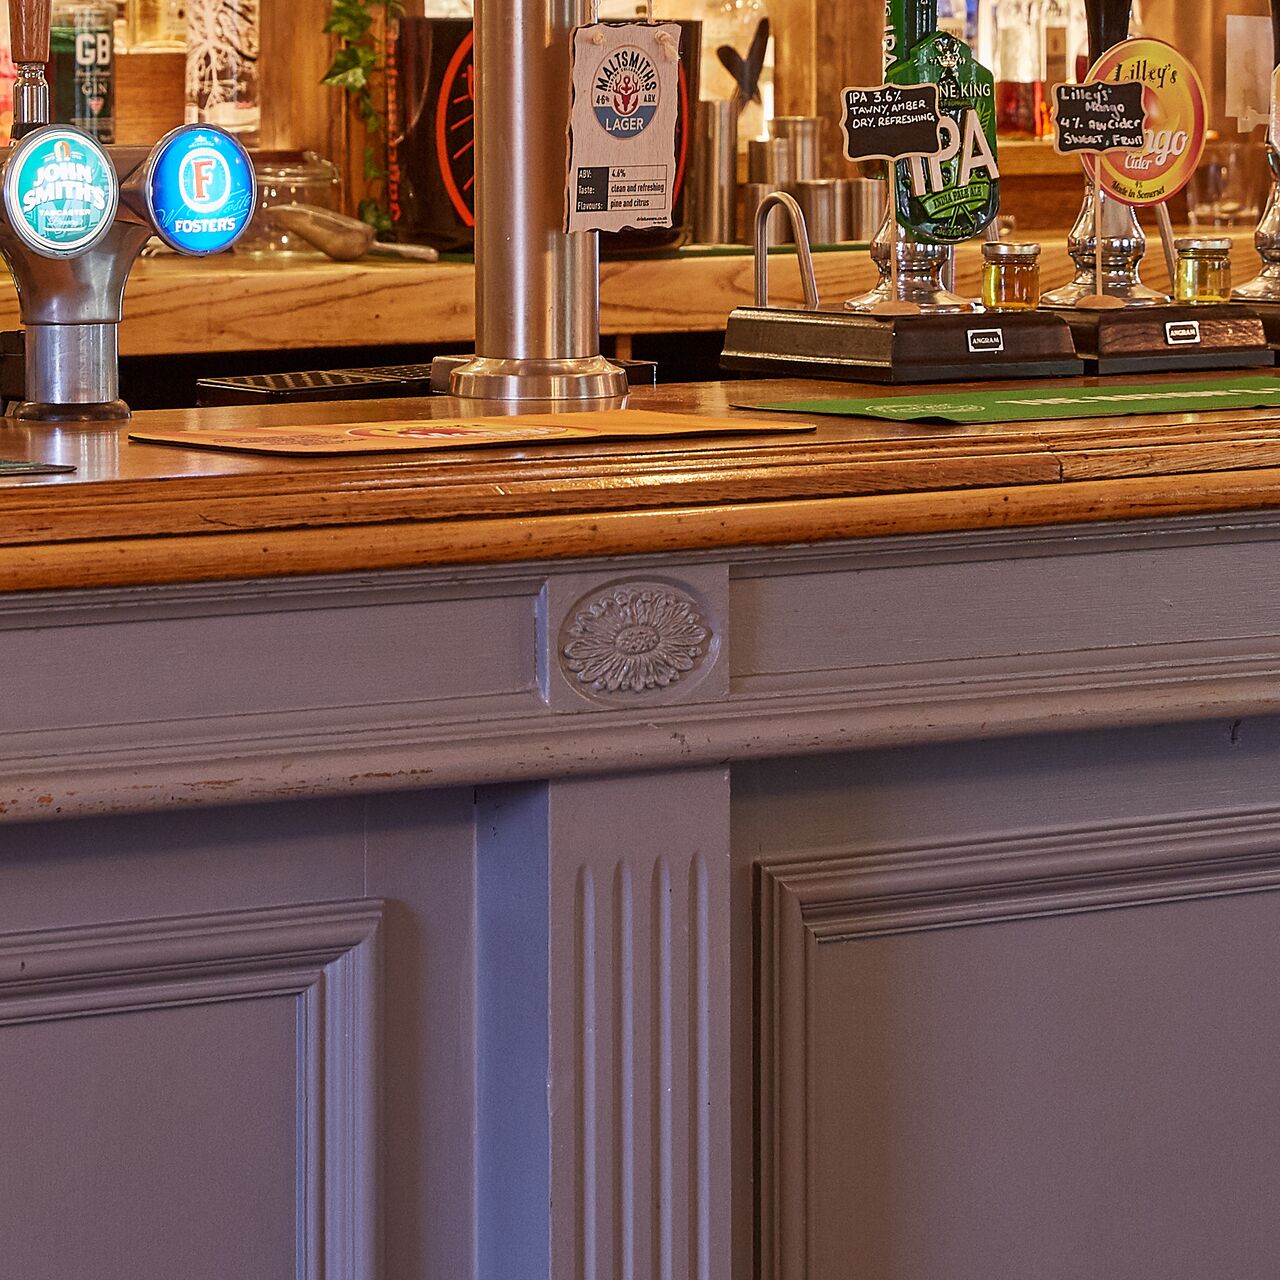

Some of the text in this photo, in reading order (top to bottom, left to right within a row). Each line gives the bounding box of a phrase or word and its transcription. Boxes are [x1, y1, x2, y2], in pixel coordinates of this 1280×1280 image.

[75, 33, 111, 65] GB
[882, 24, 898, 69] IPA
[595, 51, 657, 92] MALTSMITHS
[1114, 59, 1177, 89] Lilley's
[81, 80, 108, 96] GIN
[960, 84, 991, 98] KING
[849, 91, 902, 105] IPA 3.6%
[1085, 100, 1125, 120] Mango
[605, 117, 644, 131] LAGER
[878, 112, 935, 127] REFRESHING
[1141, 127, 1189, 165] ngo
[1124, 154, 1153, 170] Cider
[34, 161, 94, 188] JOHN
[192, 159, 214, 201] F
[578, 169, 626, 179] ABV: 4.6%
[578, 182, 664, 194] Taste: clean and refreshing
[953, 188, 970, 200] PALE
[970, 186, 982, 197] ALE
[1111, 180, 1165, 200] Made in Somerset
[23, 185, 105, 212] SMITH'S
[577, 198, 649, 210] Flavours: pine and citrus
[175, 218, 236, 234] FOSTER'S
[1170, 328, 1196, 337] ANGRAM
[972, 337, 999, 345] ANGRAM
